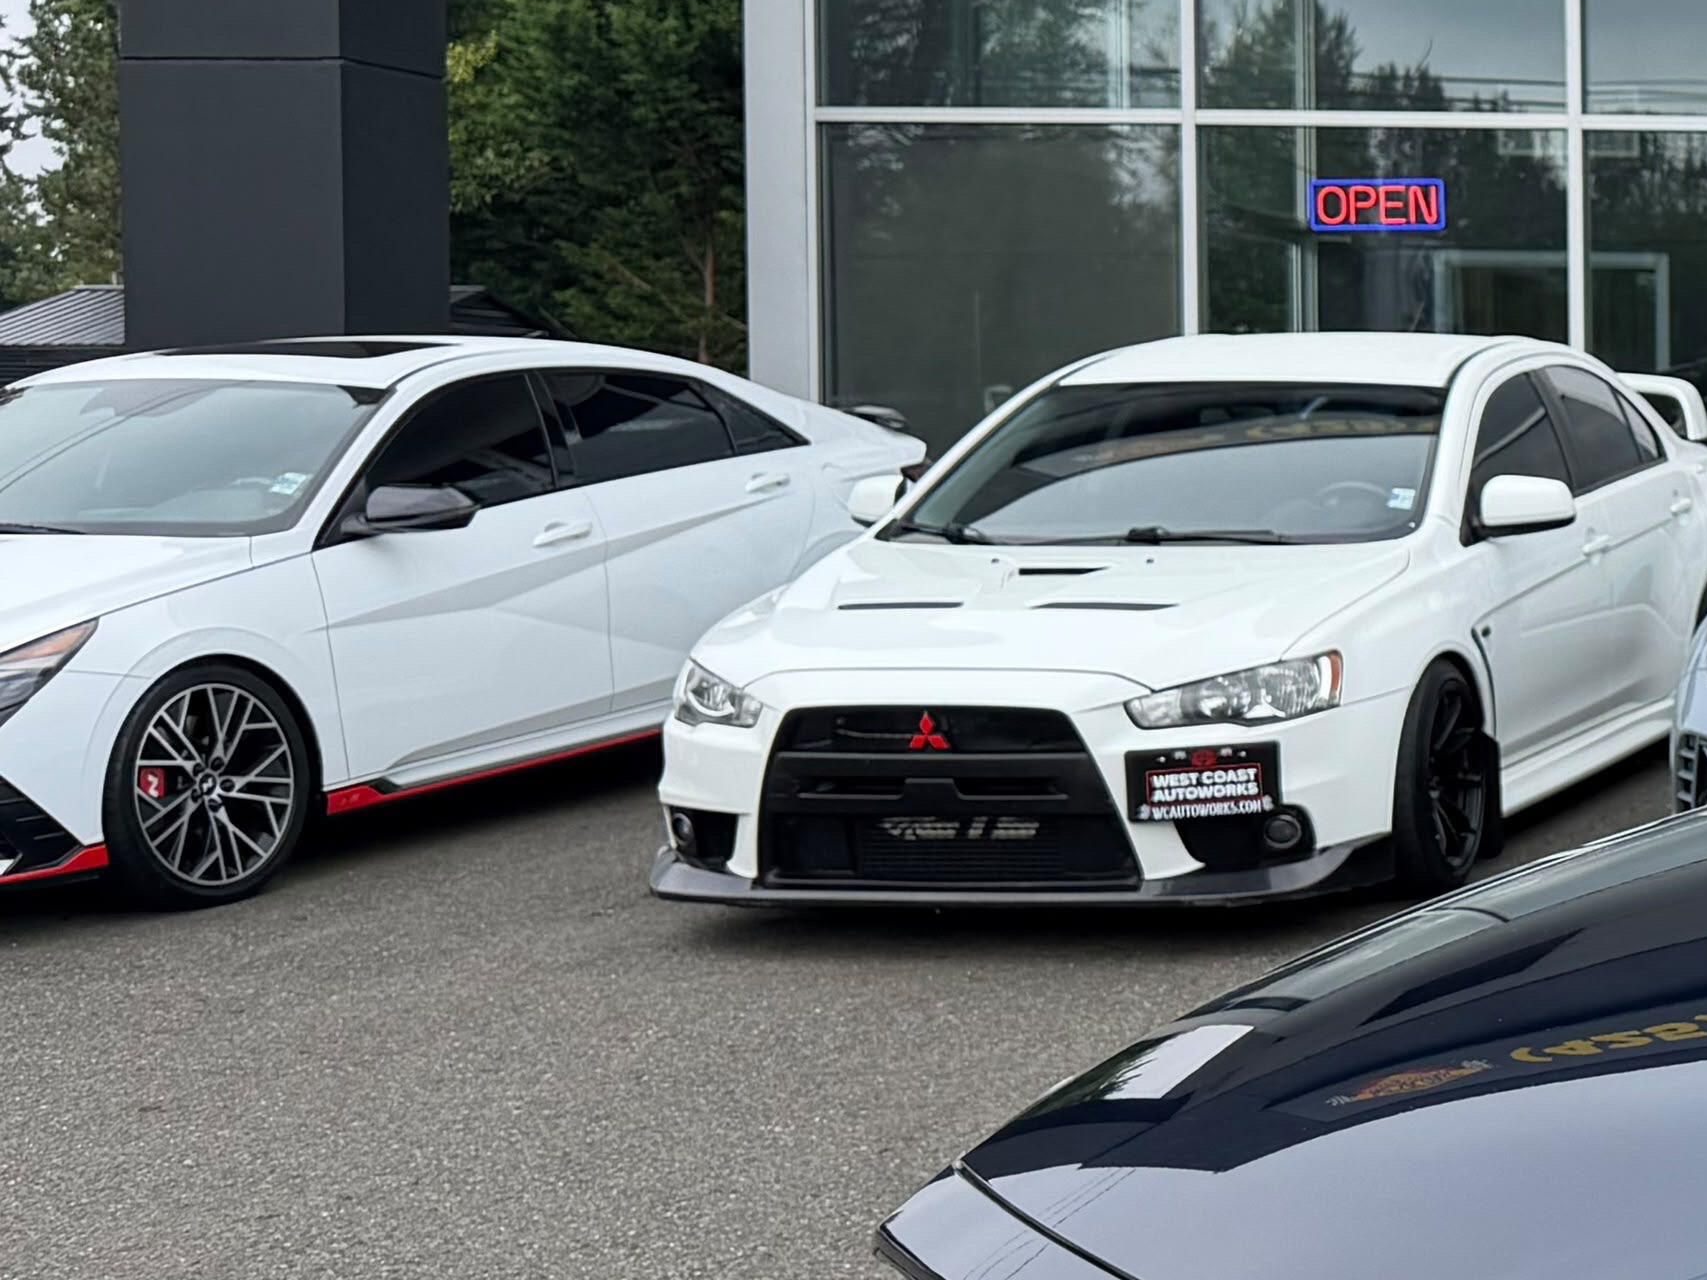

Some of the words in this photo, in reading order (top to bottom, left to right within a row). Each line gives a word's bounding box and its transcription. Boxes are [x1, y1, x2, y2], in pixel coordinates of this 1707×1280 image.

[1316, 185, 1438, 225] OPEN
[1152, 772, 1199, 788] WEST
[1201, 768, 1258, 785] COAST
[1151, 782, 1259, 803] AUTOWORKS
